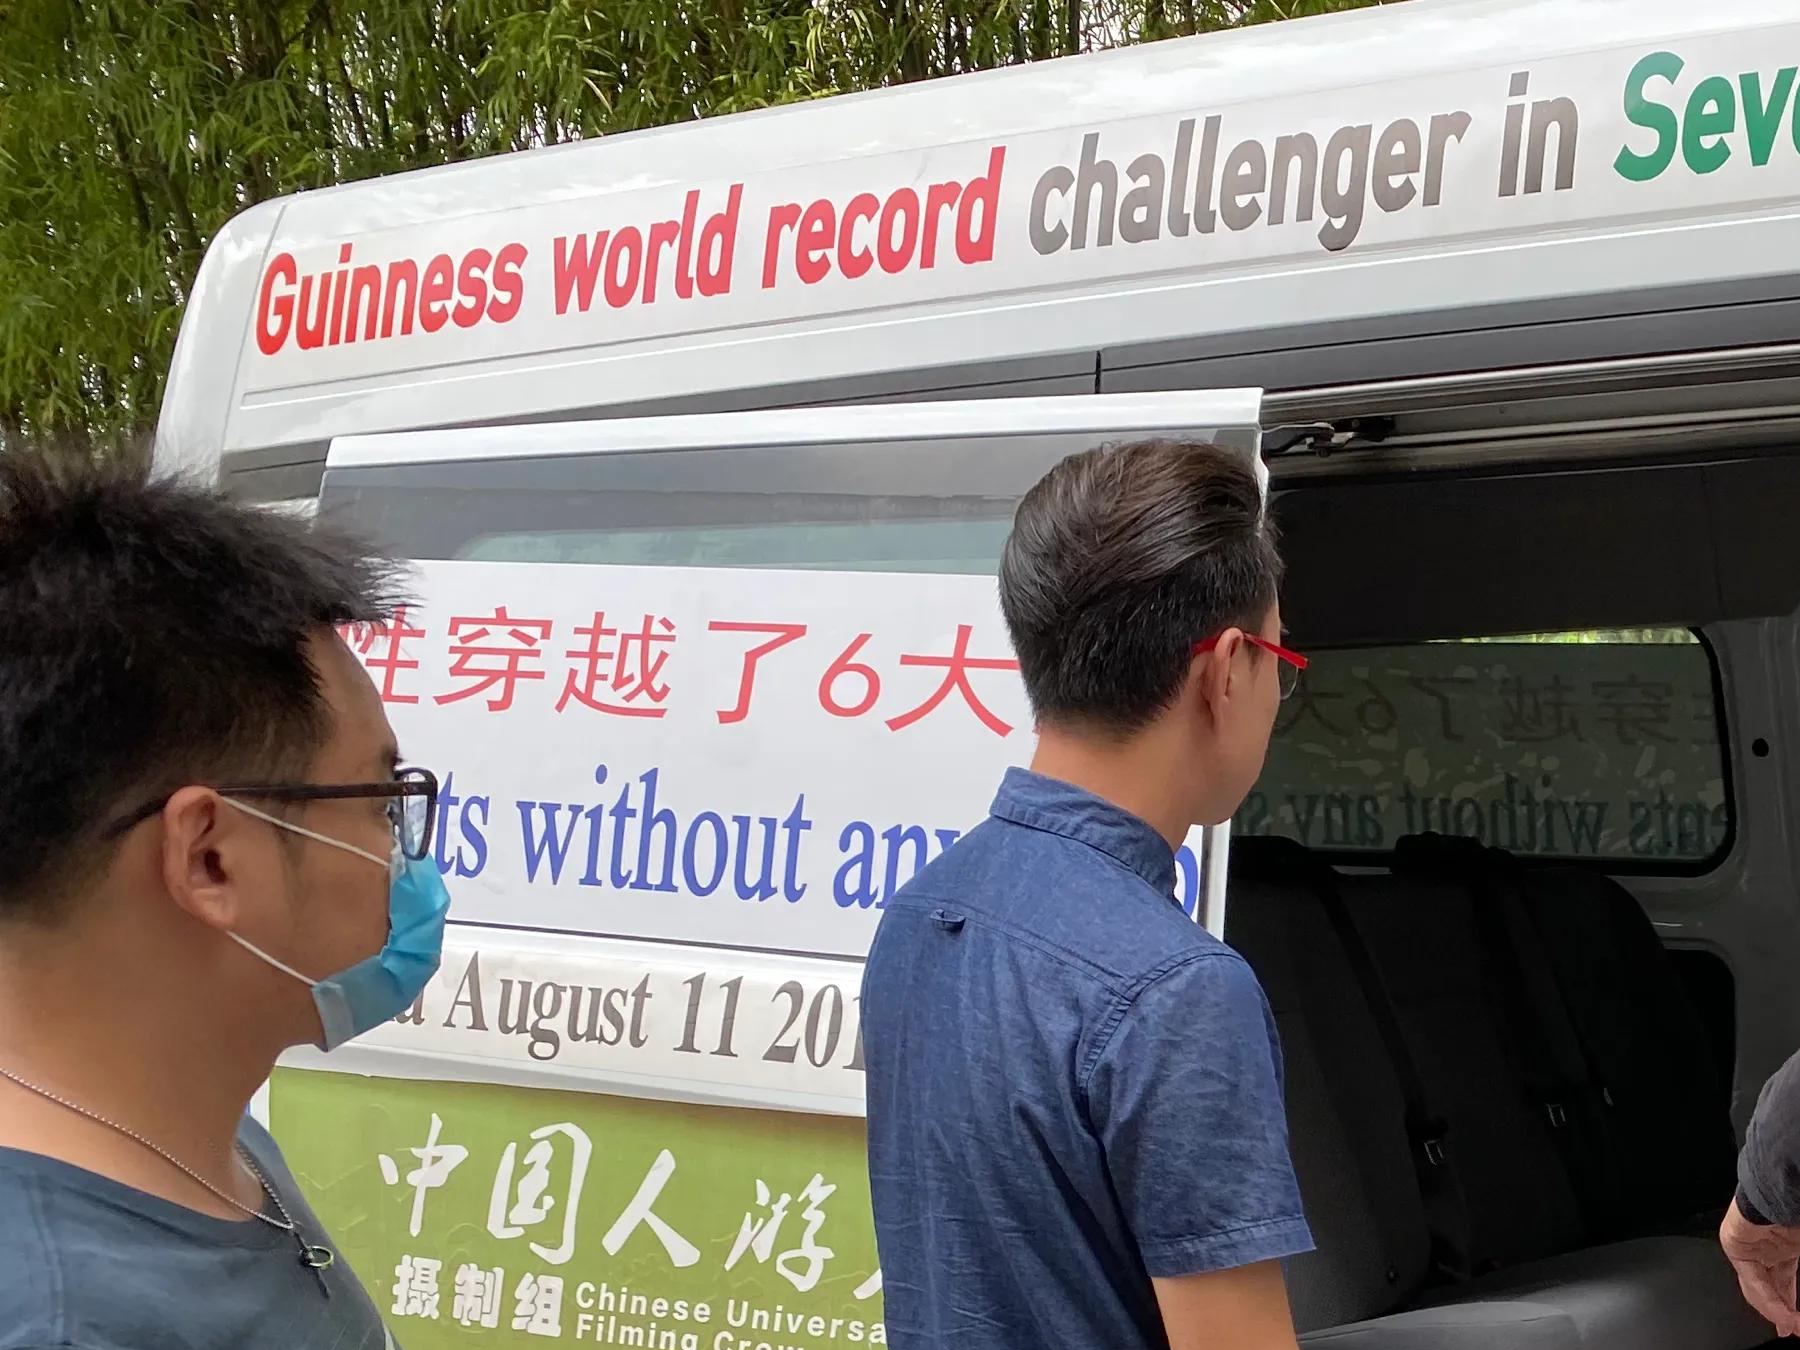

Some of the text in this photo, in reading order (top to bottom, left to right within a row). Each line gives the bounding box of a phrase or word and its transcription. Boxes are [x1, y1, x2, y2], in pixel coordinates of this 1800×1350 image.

[255, 243, 525, 356] Guinness
[553, 183, 745, 315] world
[761, 146, 1007, 290] record
[1029, 114, 1472, 255] challenger
[1499, 70, 1579, 198] in
[516, 764, 812, 902] without
[833, 821, 960, 909] an
[443, 950, 653, 1060] August
[672, 972, 741, 1057] 11
[391, 1254, 564, 1338] 摄制组
[576, 1282, 711, 1323] Chinese
